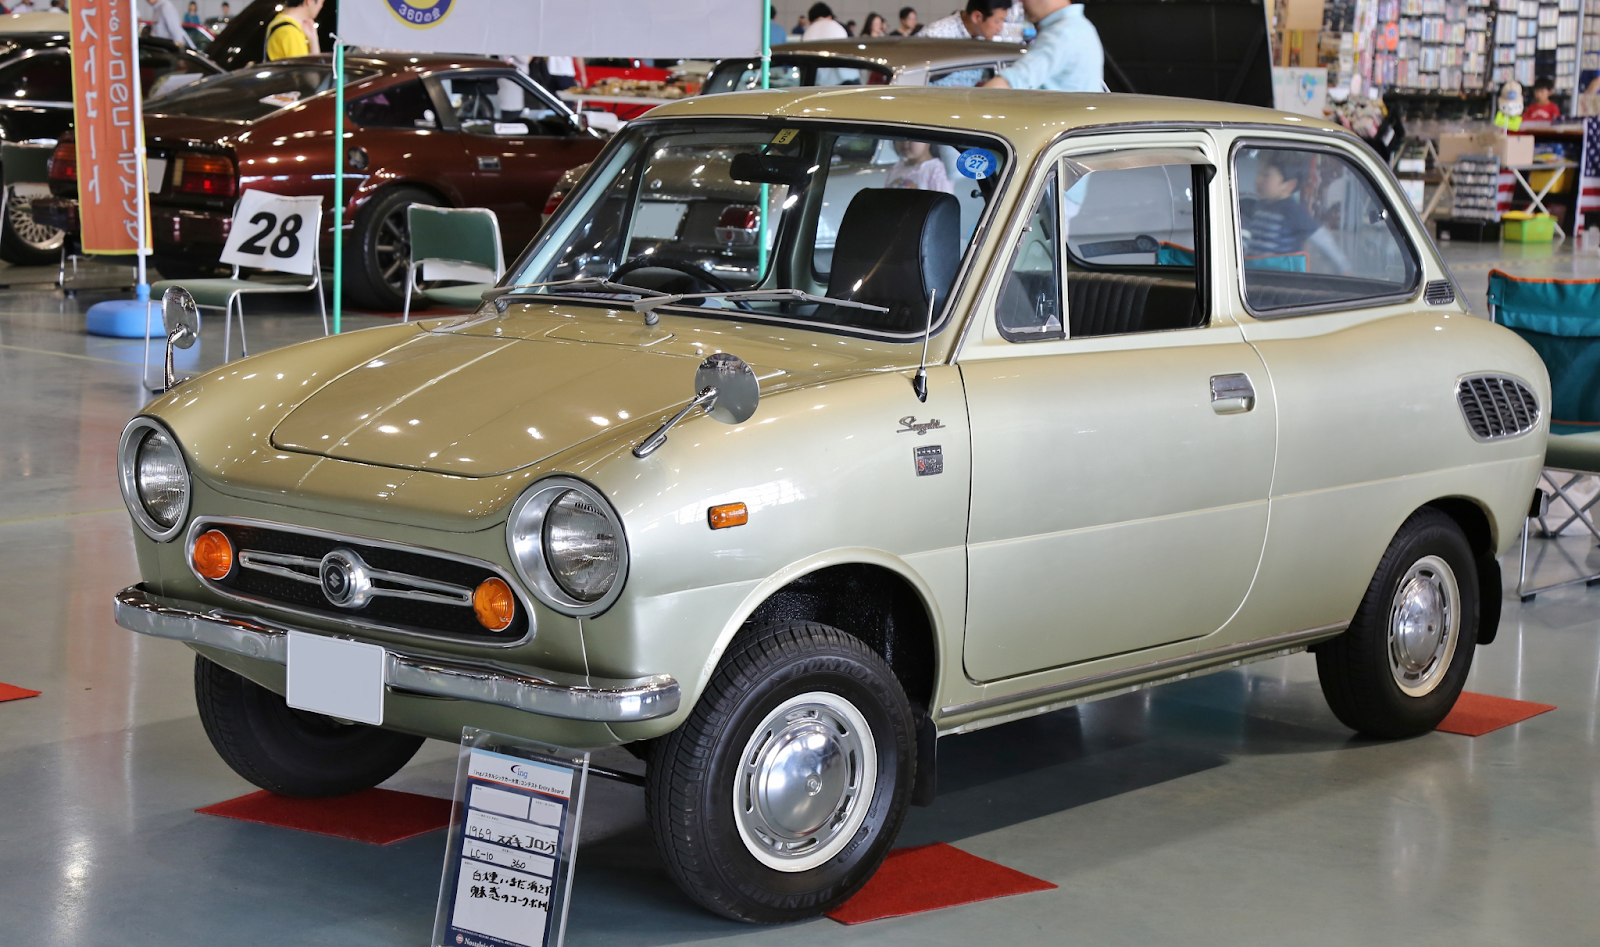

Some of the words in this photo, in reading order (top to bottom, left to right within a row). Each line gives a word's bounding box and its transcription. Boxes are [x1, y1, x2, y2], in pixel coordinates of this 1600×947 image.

[398, 4, 441, 22] 360の会
[968, 159, 984, 170] 27
[236, 211, 303, 258] 28
[791, 658, 880, 686] DUNLOP
[538, 784, 551, 793] Entry
[551, 787, 565, 795] Board
[496, 834, 524, 849] スズキ
[470, 848, 494, 861] LC-10
[511, 859, 526, 869] 360
